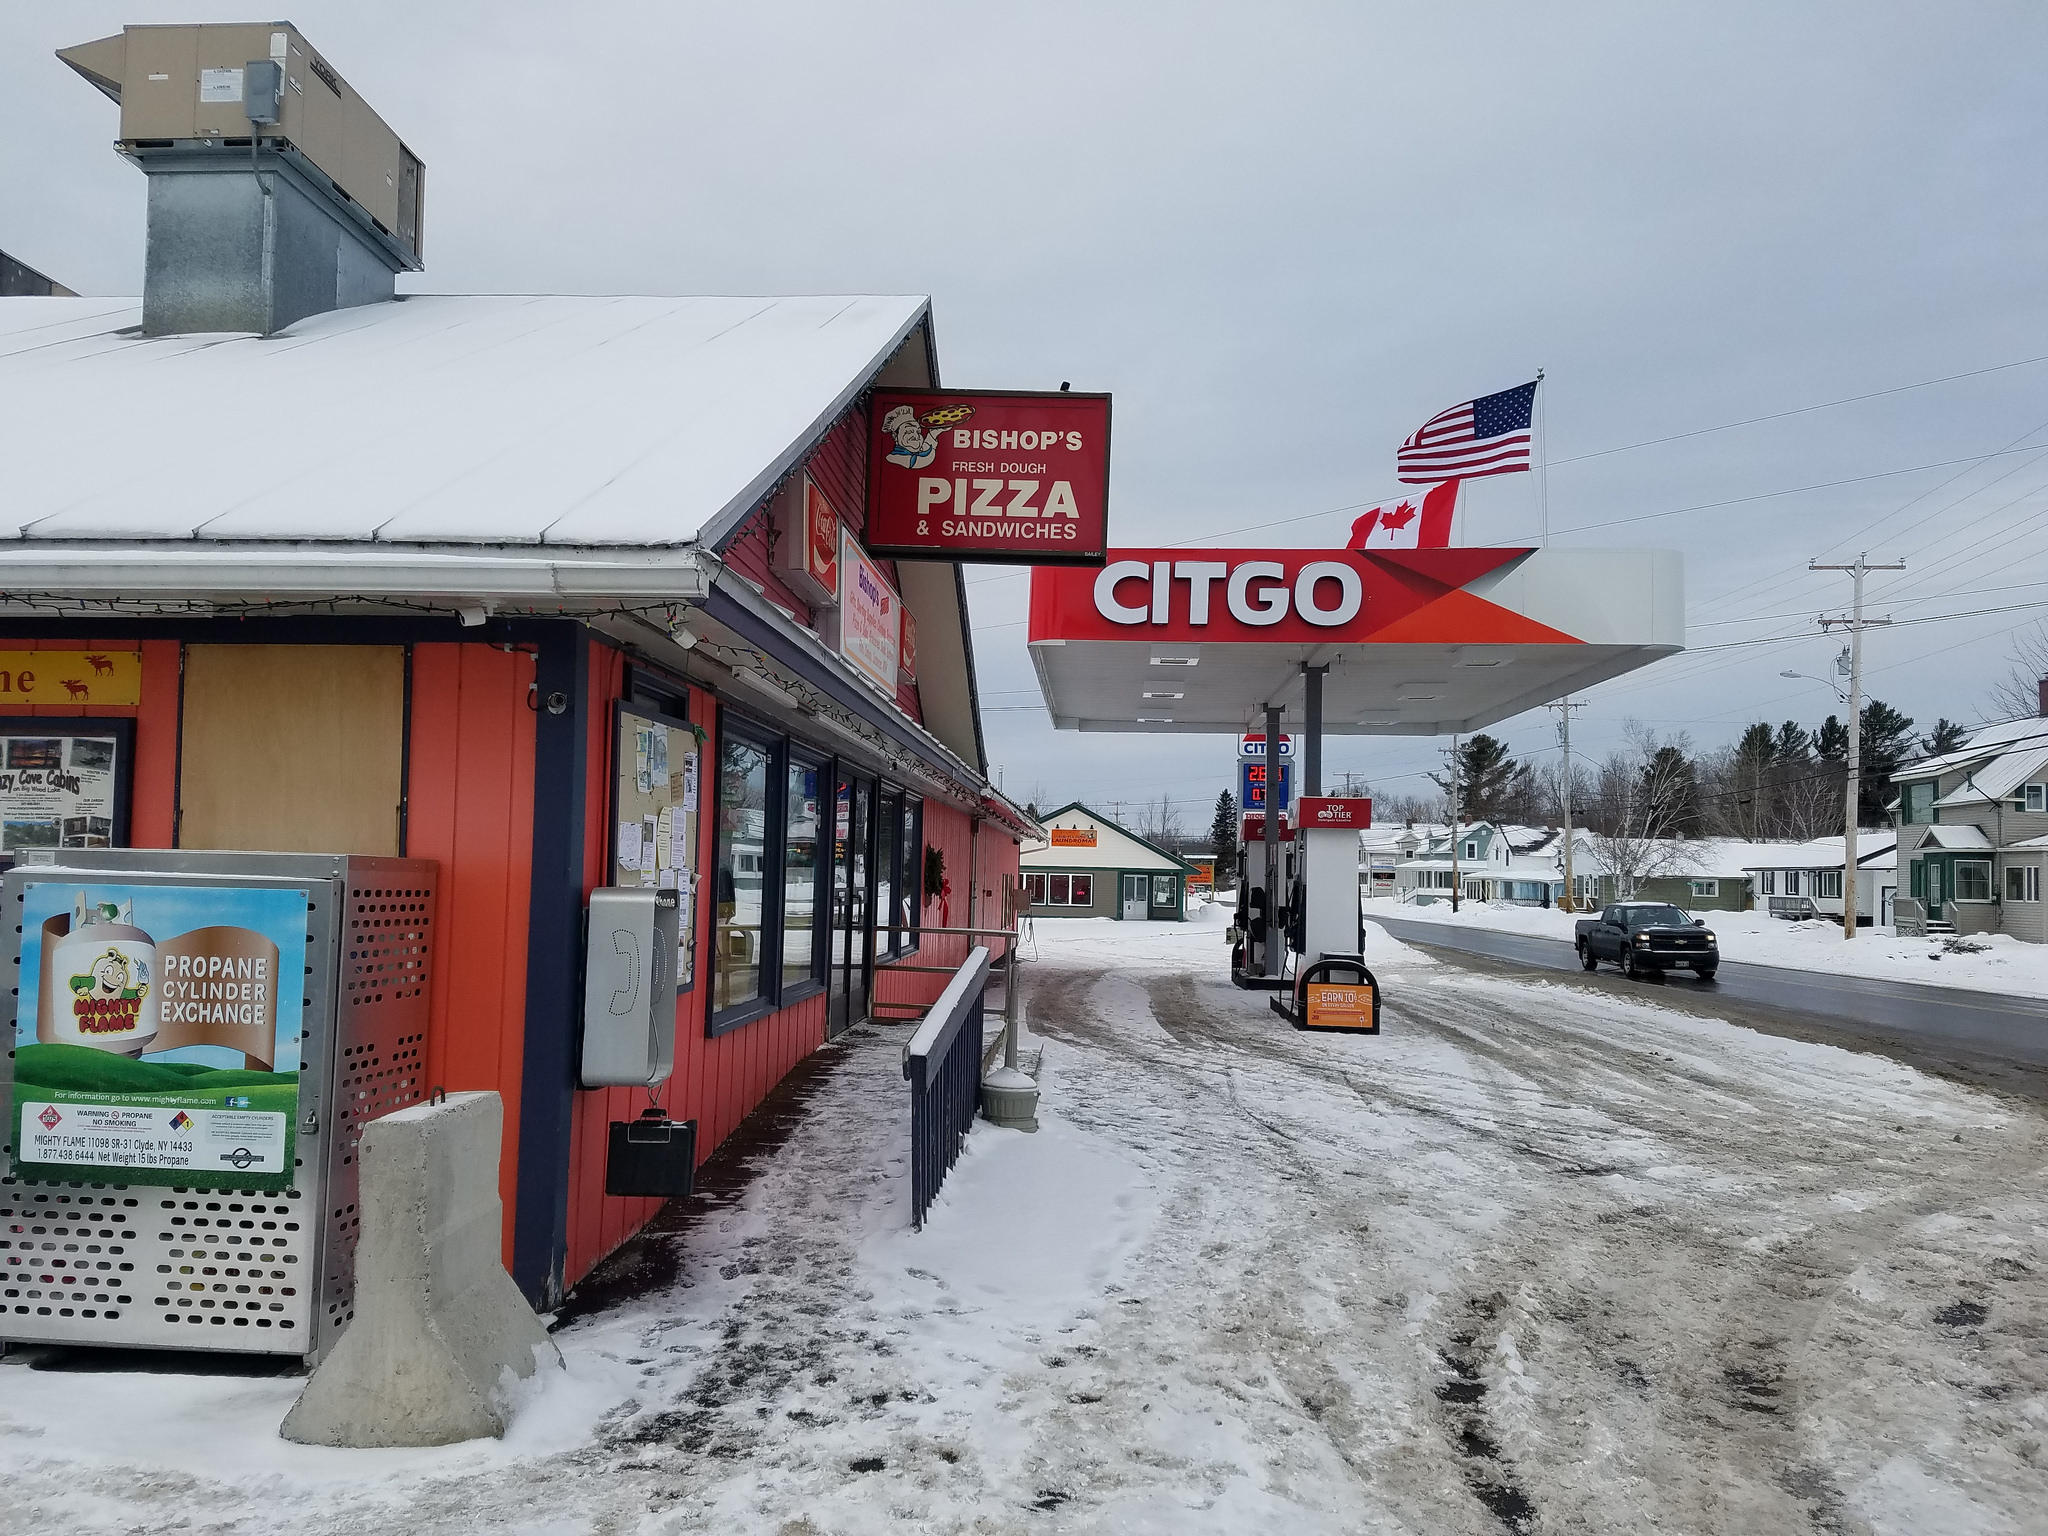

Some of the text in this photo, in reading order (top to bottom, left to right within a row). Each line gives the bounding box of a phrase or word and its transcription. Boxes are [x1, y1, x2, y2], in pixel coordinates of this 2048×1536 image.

[313, 56, 339, 89] YORK
[953, 429, 1083, 451] BISHOP'S
[952, 462, 1046, 474] FRESH DOUGH
[917, 477, 1080, 519] PIZZA
[917, 520, 1077, 540] & SANDWICHES
[1093, 560, 1362, 626] CITGO
[1244, 743, 1289, 754] CITO
[18, 769, 42, 785] Cove
[46, 769, 81, 795] Cabins
[1326, 804, 1345, 812] TOP
[1333, 811, 1352, 819] TIER
[164, 955, 268, 979] PROPANE
[163, 981, 266, 1001] CYLINDER
[1321, 992, 1344, 1002] EARN
[74, 998, 142, 1016] MIGHTY
[160, 1001, 266, 1025] EXCHANGE
[79, 1013, 136, 1033] FLAME
[55, 1091, 65, 1099] For
[68, 1092, 110, 1101] information
[111, 1095, 121, 1103] go
[131, 1096, 217, 1105] www.mightyflame.com
[77, 1110, 109, 1118] WARNING
[104, 1119, 137, 1127] SMOKING
[34, 1135, 193, 1153] MIGHTY FLAME 11098 SR-31 Clyde, NY 14433
[38, 1148, 189, 1167] 1.877.438.6444 Net Weight 15 lbs Propane
